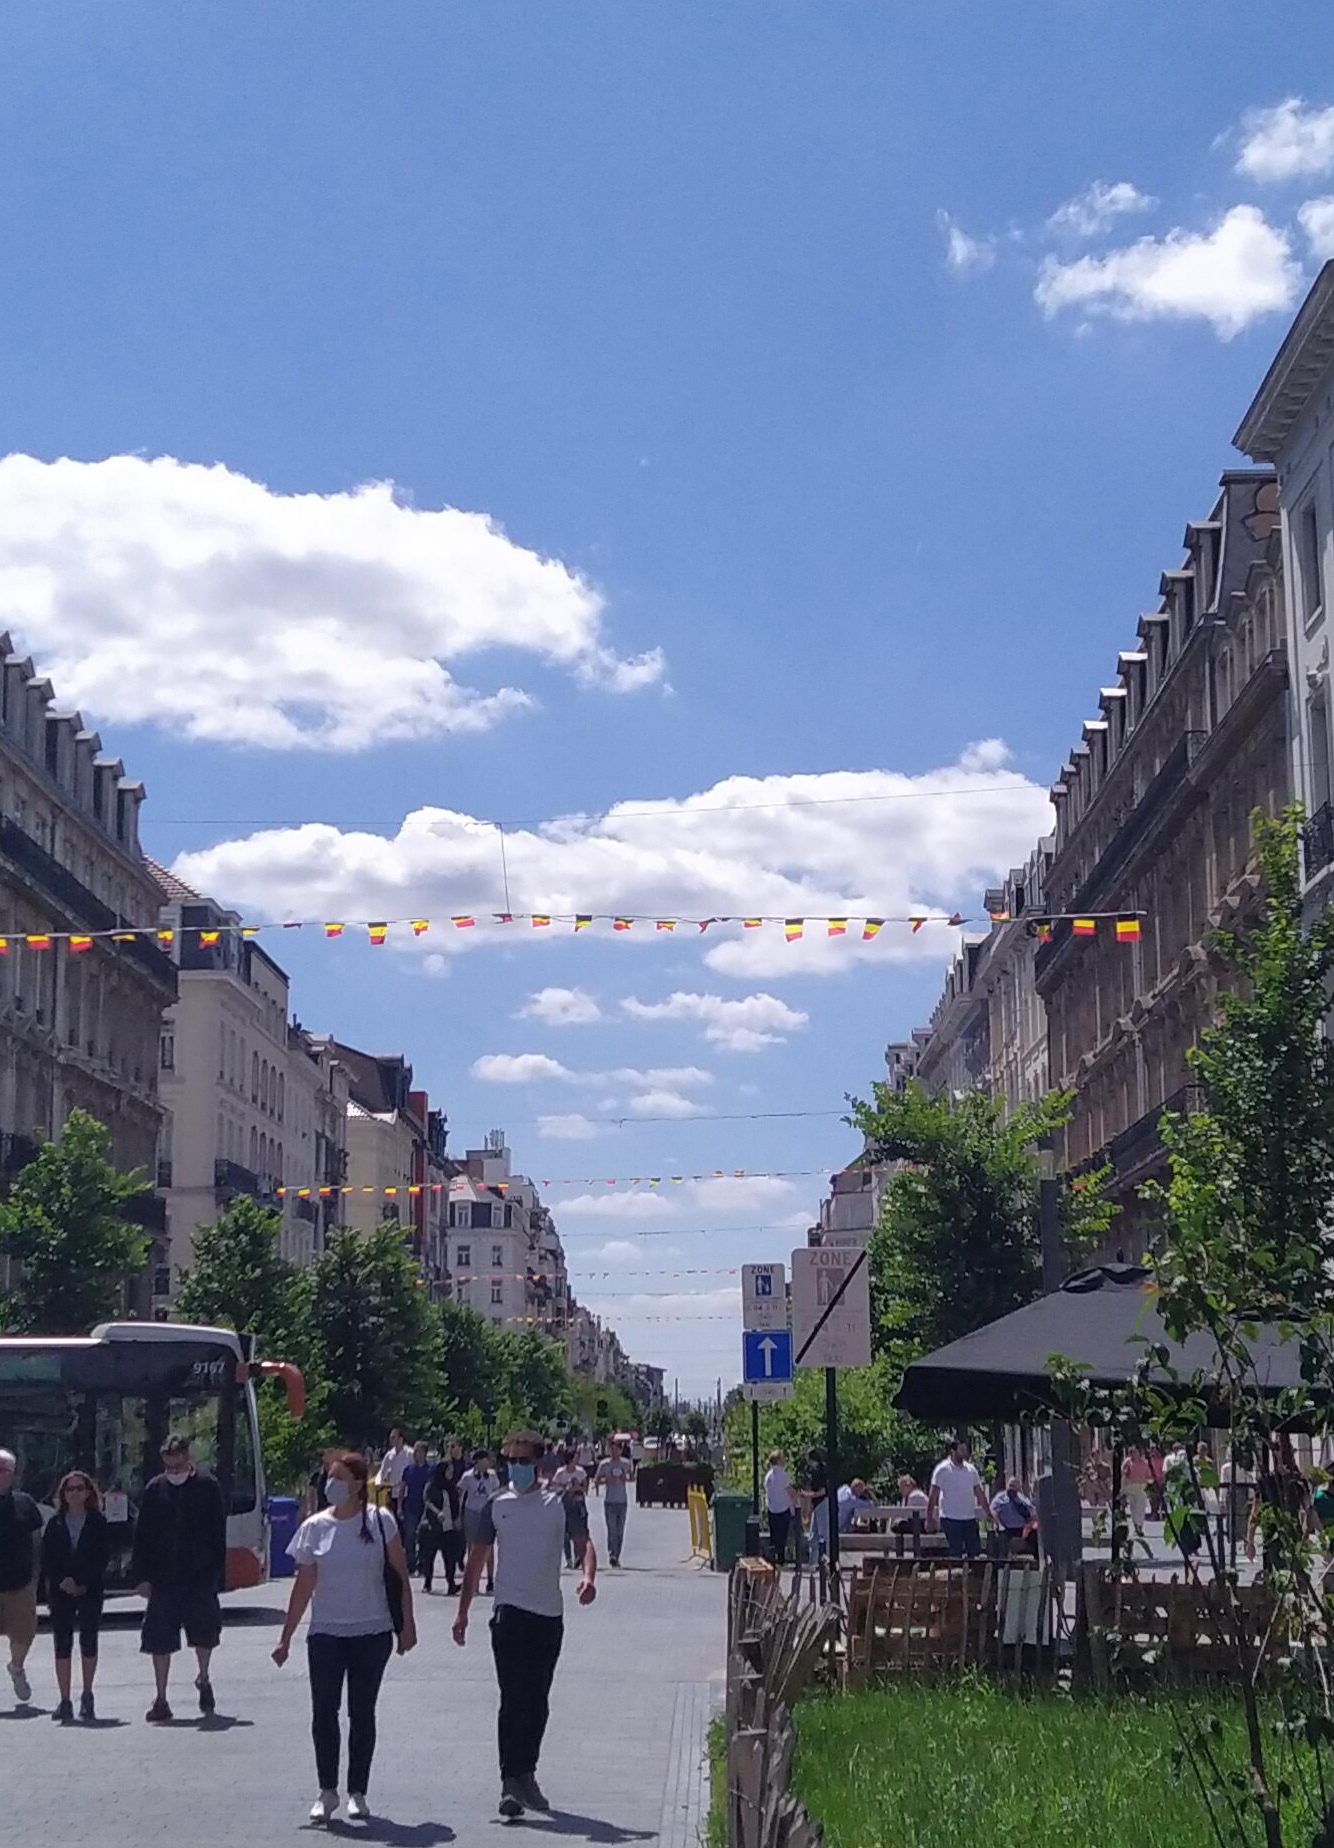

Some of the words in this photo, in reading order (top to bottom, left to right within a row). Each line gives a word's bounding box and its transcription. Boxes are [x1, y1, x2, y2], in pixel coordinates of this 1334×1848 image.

[810, 1252, 851, 1265] ZONE
[751, 1266, 774, 1274] ZONE
[193, 1361, 225, 1373] 9167
